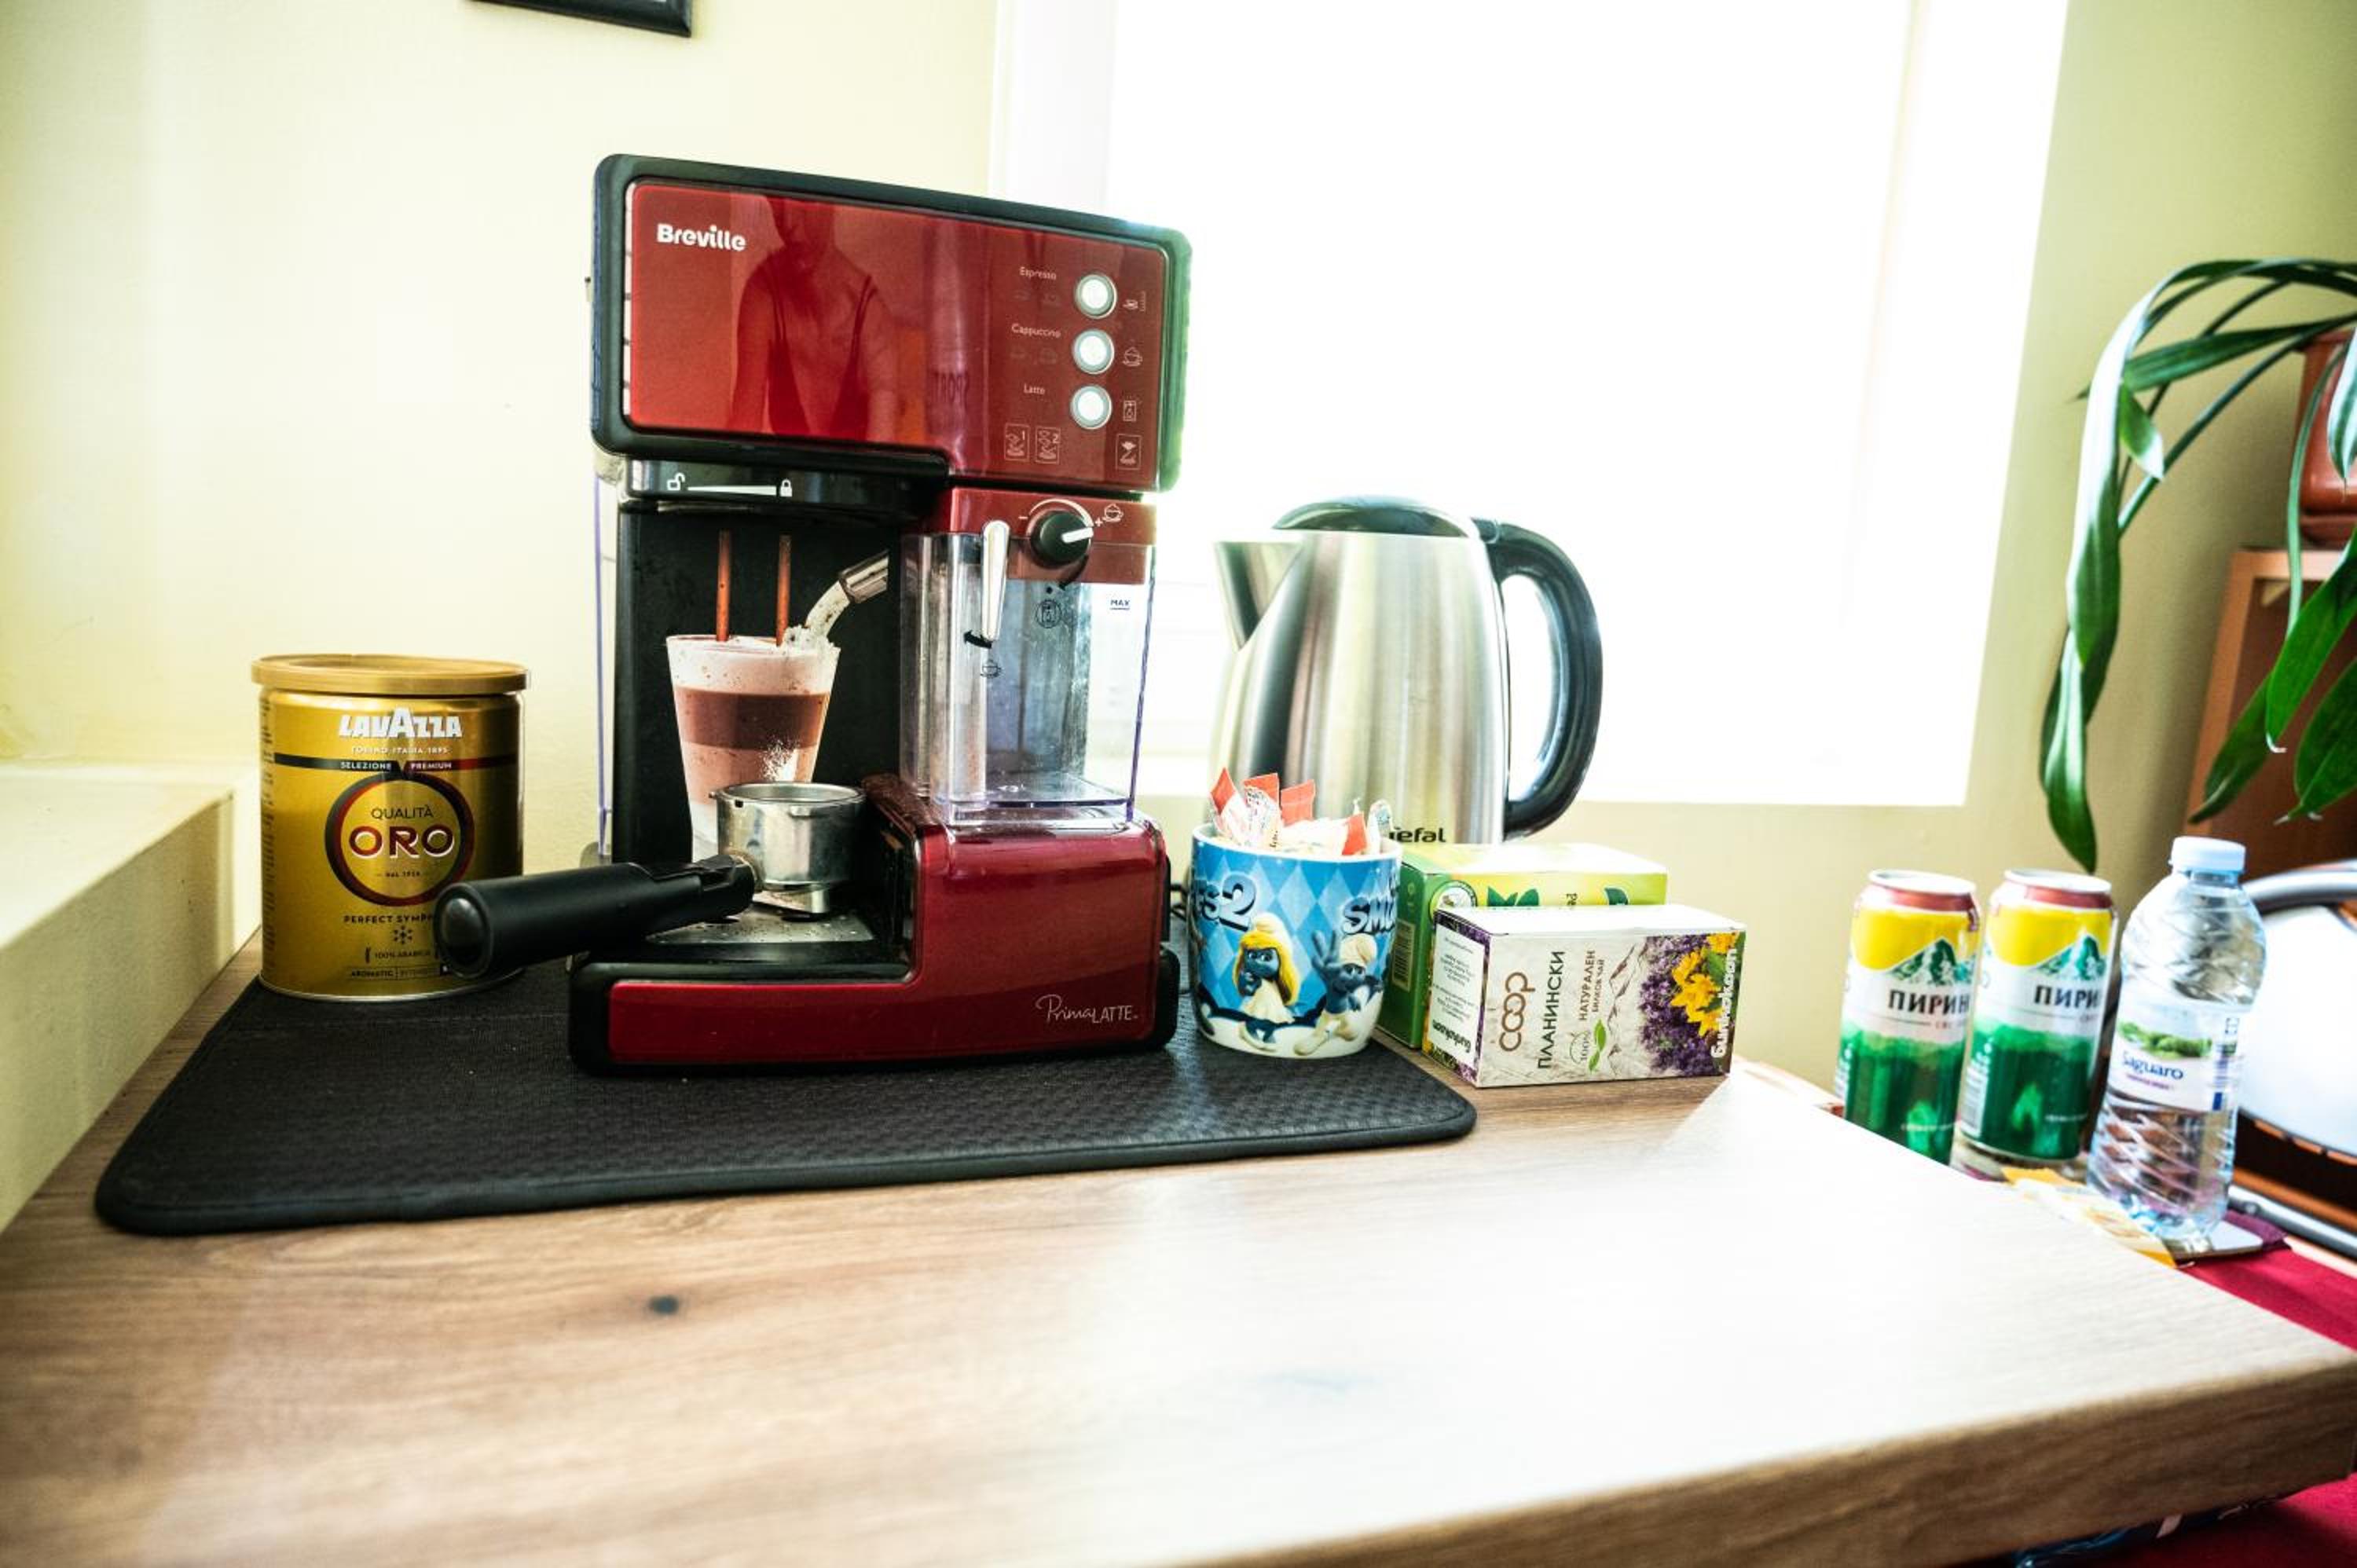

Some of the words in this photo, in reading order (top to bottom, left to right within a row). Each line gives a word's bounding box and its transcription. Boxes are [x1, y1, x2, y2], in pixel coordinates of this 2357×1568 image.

[657, 222, 746, 251] Breville
[1019, 266, 1058, 280] Espresso
[1011, 323, 1061, 339] Cappuccino
[1024, 383, 1046, 394] Latte
[339, 706, 464, 738] LAVAZZA
[339, 761, 393, 770] SELEZIONE
[409, 761, 453, 770] PREMIUM
[370, 804, 434, 821] QUALITÀ
[348, 824, 456, 859] ORO
[343, 915, 394, 924] PERFECT
[1578, 950, 1596, 1021] НАТУРАЛЕН
[1537, 951, 1566, 1069] ПЛАНИНСКИ
